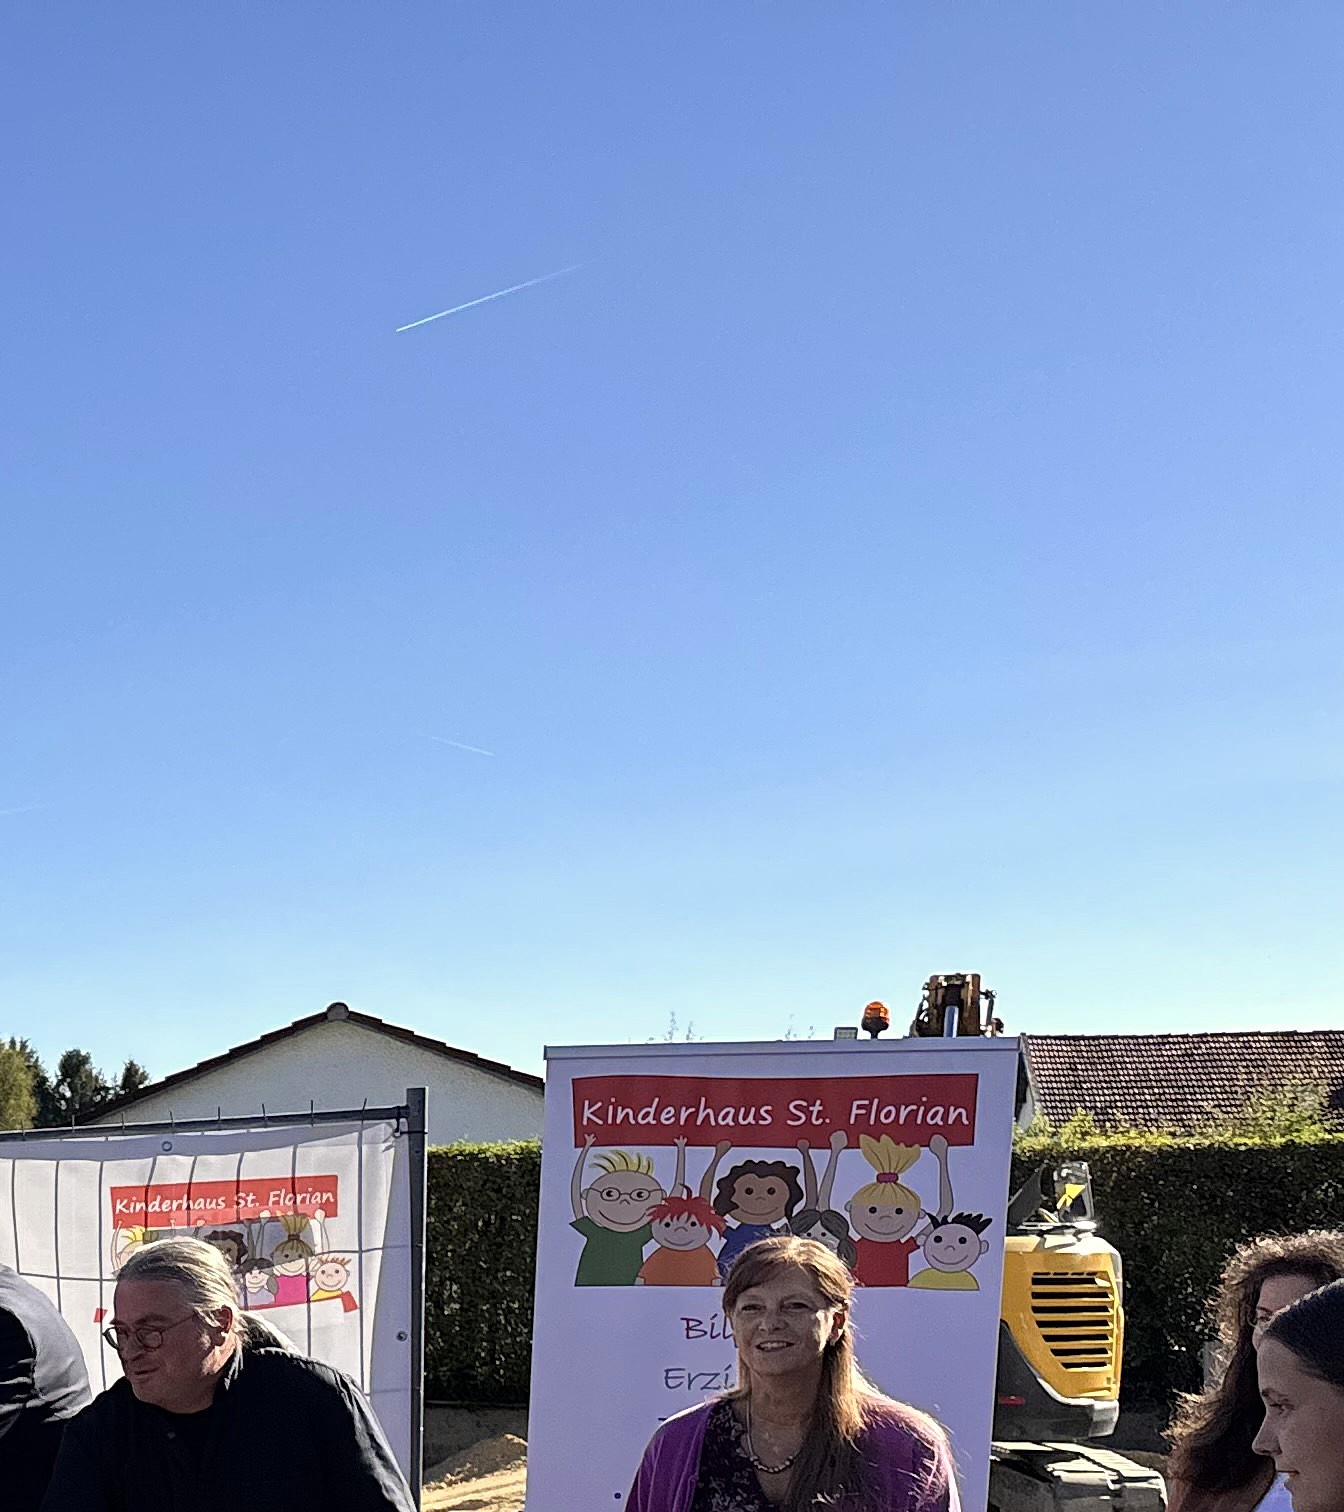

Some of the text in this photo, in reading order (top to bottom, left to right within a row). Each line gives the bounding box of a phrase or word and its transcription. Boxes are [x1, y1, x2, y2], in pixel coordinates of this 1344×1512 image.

[582, 1097, 971, 1127] Kinderhaus St. Florian
[115, 1188, 336, 1215] Kinderhaus St. Florian
